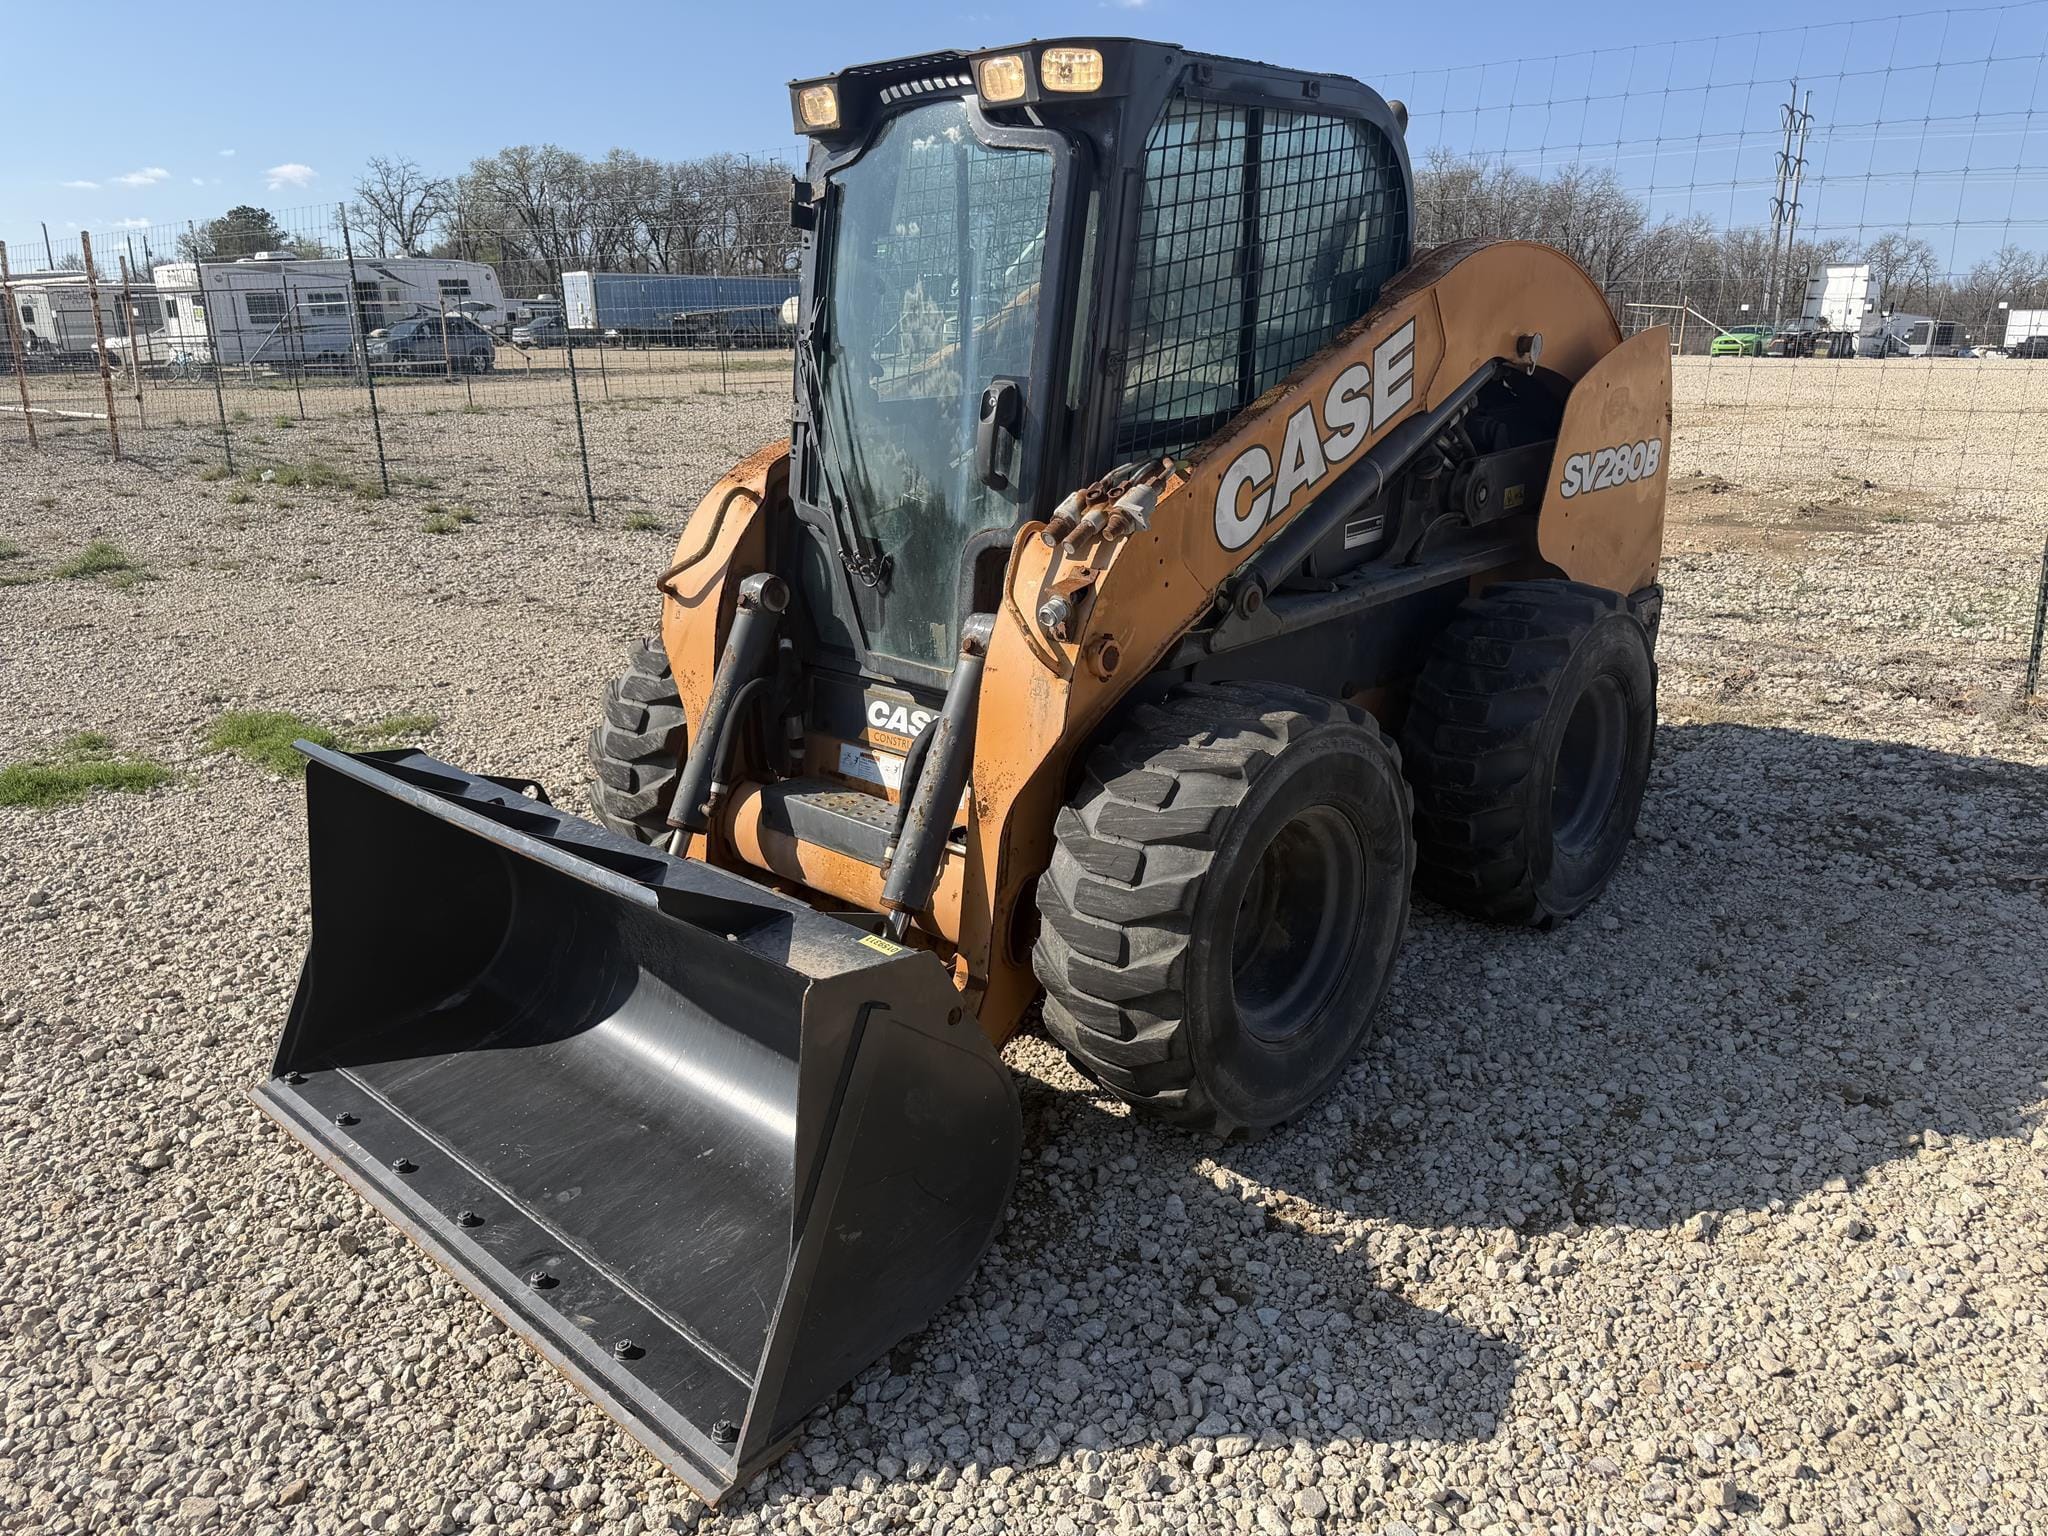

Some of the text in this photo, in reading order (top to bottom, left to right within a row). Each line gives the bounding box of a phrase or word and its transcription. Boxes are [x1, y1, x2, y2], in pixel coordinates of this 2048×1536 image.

[1214, 315, 1416, 552] CASE
[1560, 438, 1662, 499] SV280B
[868, 701, 940, 737] CAS
